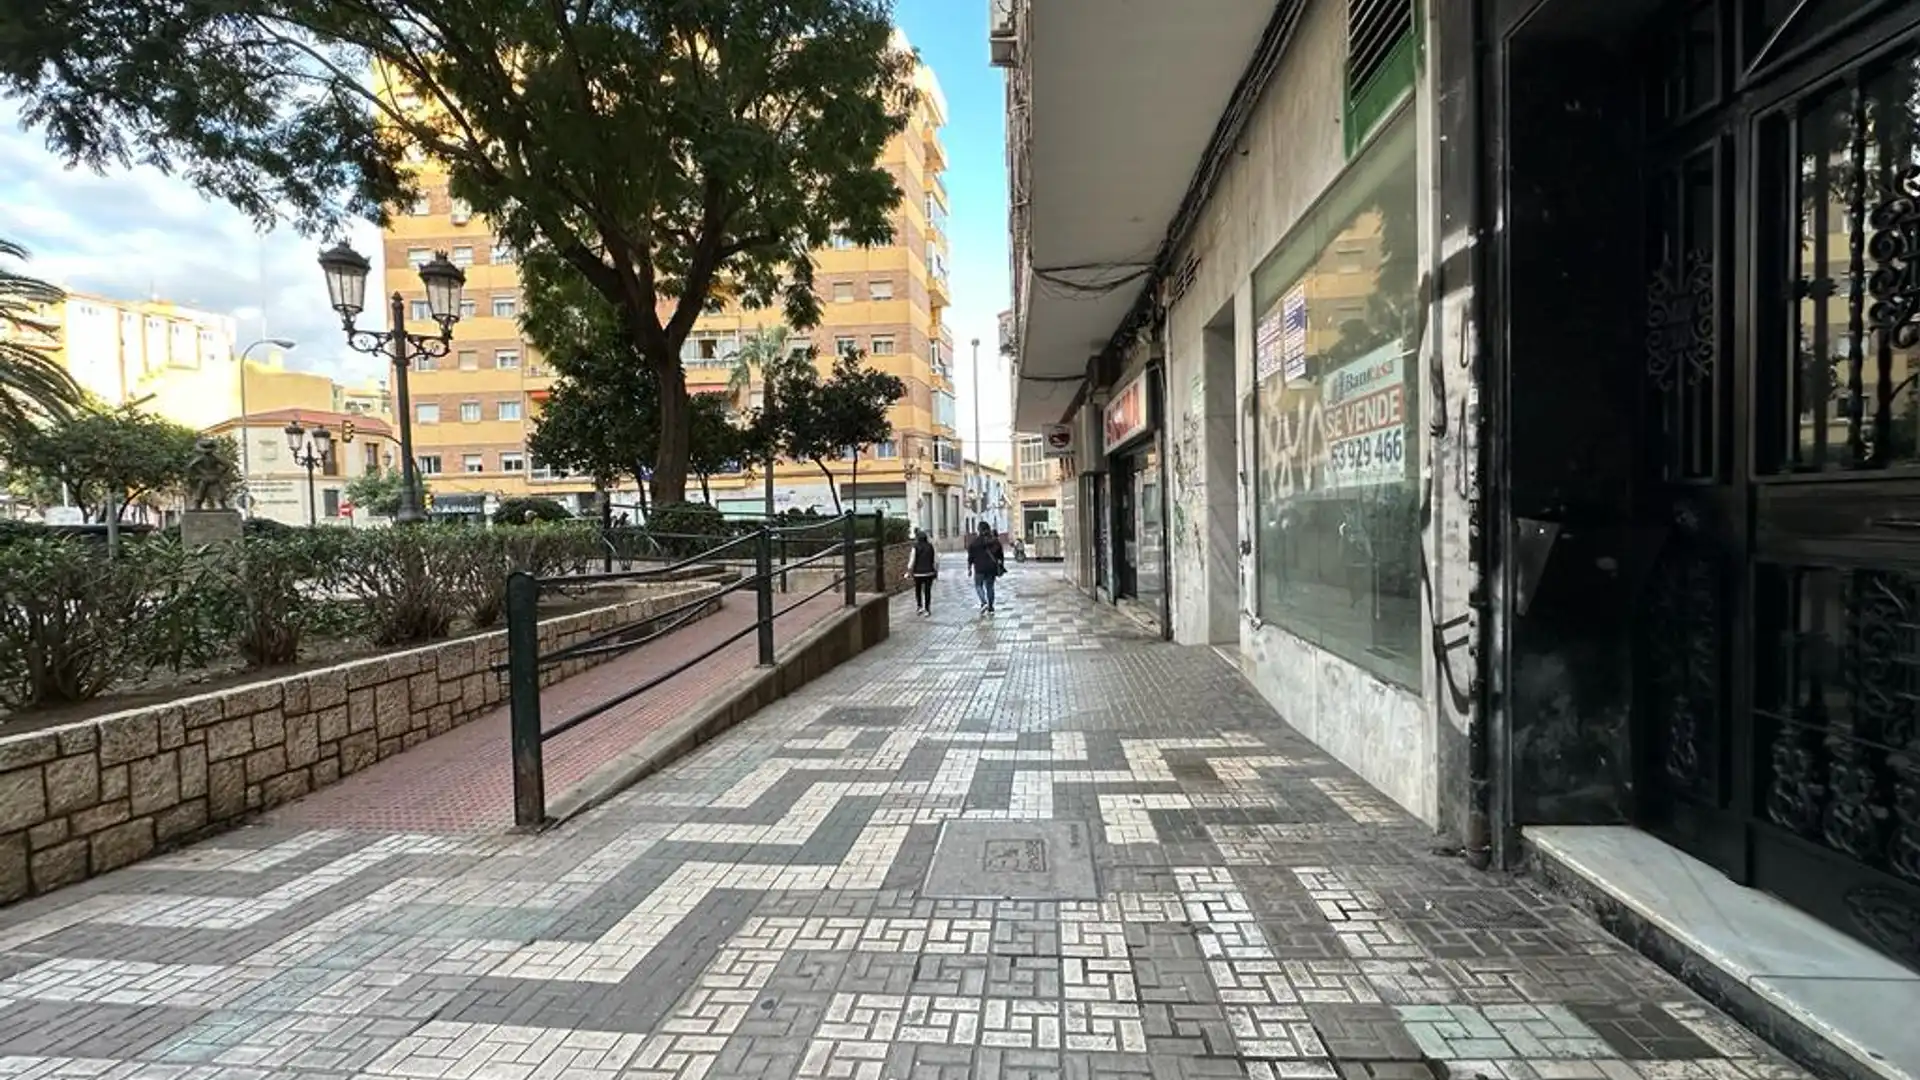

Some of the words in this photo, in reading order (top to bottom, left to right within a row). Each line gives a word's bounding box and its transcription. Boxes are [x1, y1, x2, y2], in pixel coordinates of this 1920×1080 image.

[1326, 409, 1343, 439] SE
[1345, 388, 1401, 434] VENDE
[1348, 437, 1371, 469] 929
[1374, 428, 1402, 464] 466
